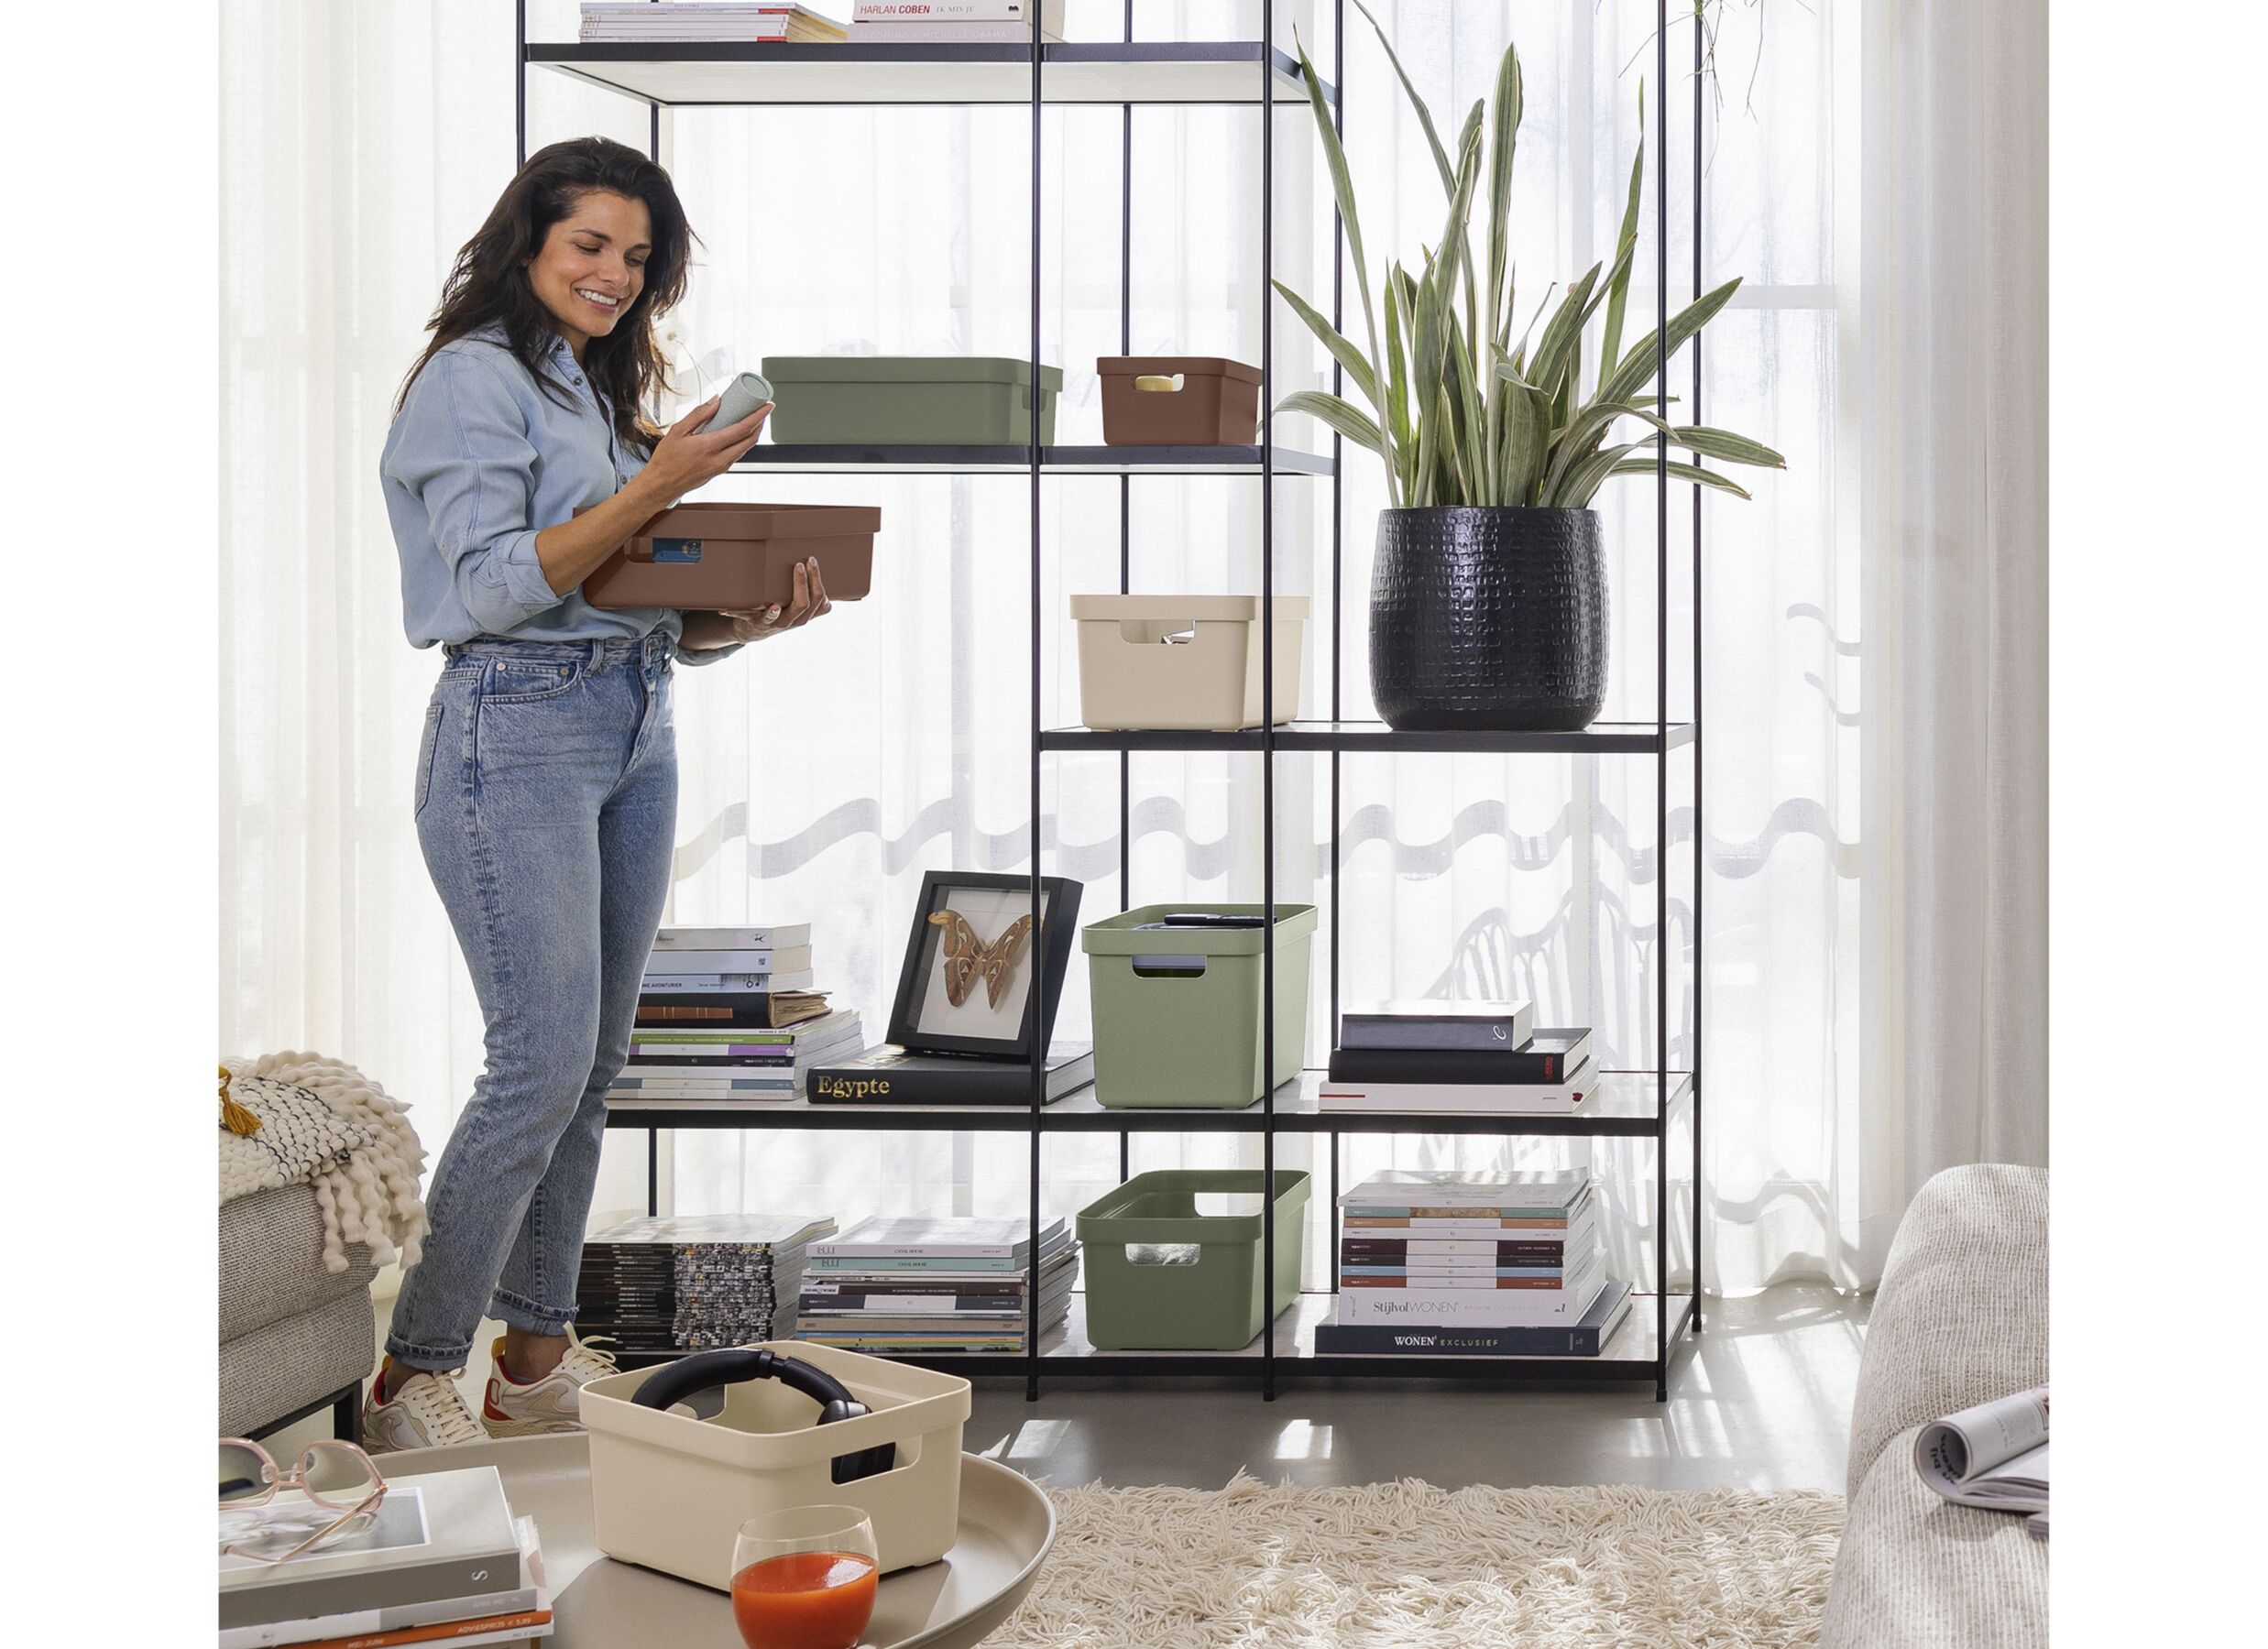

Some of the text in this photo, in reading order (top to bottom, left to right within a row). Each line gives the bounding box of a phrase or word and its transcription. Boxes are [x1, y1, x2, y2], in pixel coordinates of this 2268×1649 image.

[860, 5, 896, 14] HARLAN
[898, 5, 930, 14] COBEN
[971, 30, 1008, 38] OBAMA
[817, 1076, 891, 1098] Egypte
[1394, 1336, 1435, 1347] WONEN
